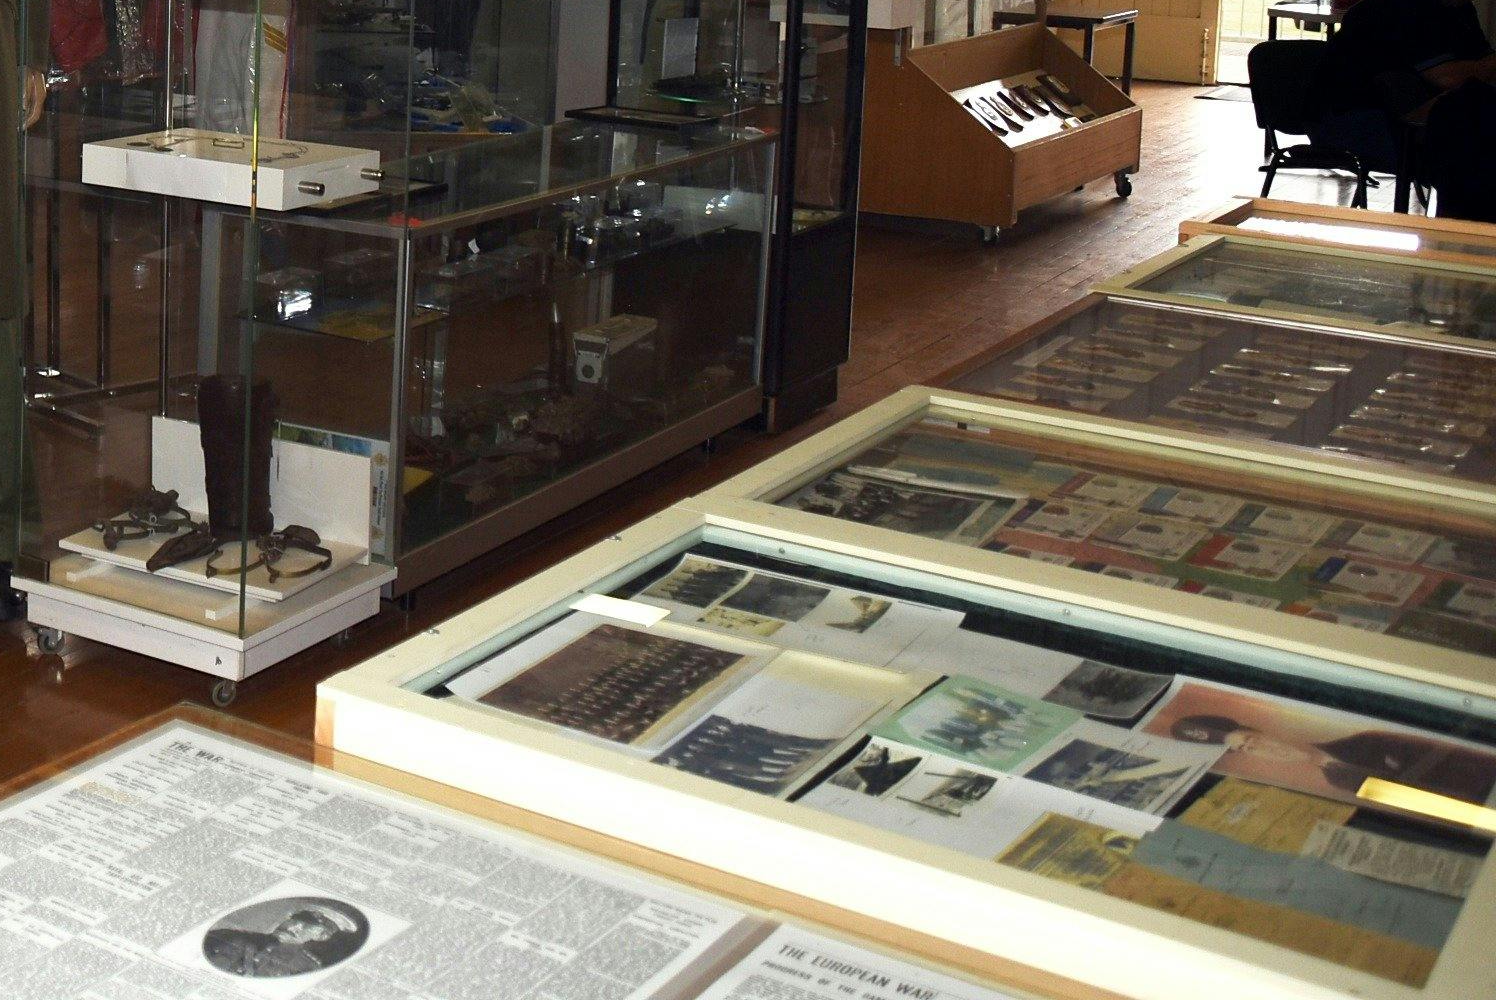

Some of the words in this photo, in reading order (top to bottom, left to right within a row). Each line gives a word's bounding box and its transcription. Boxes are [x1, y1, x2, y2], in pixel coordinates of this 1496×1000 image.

[167, 740, 192, 754] THE
[196, 750, 224, 763] WAR
[778, 944, 808, 961] THE
[811, 955, 891, 988] EUROPEAN
[896, 982, 939, 1000] WAR
